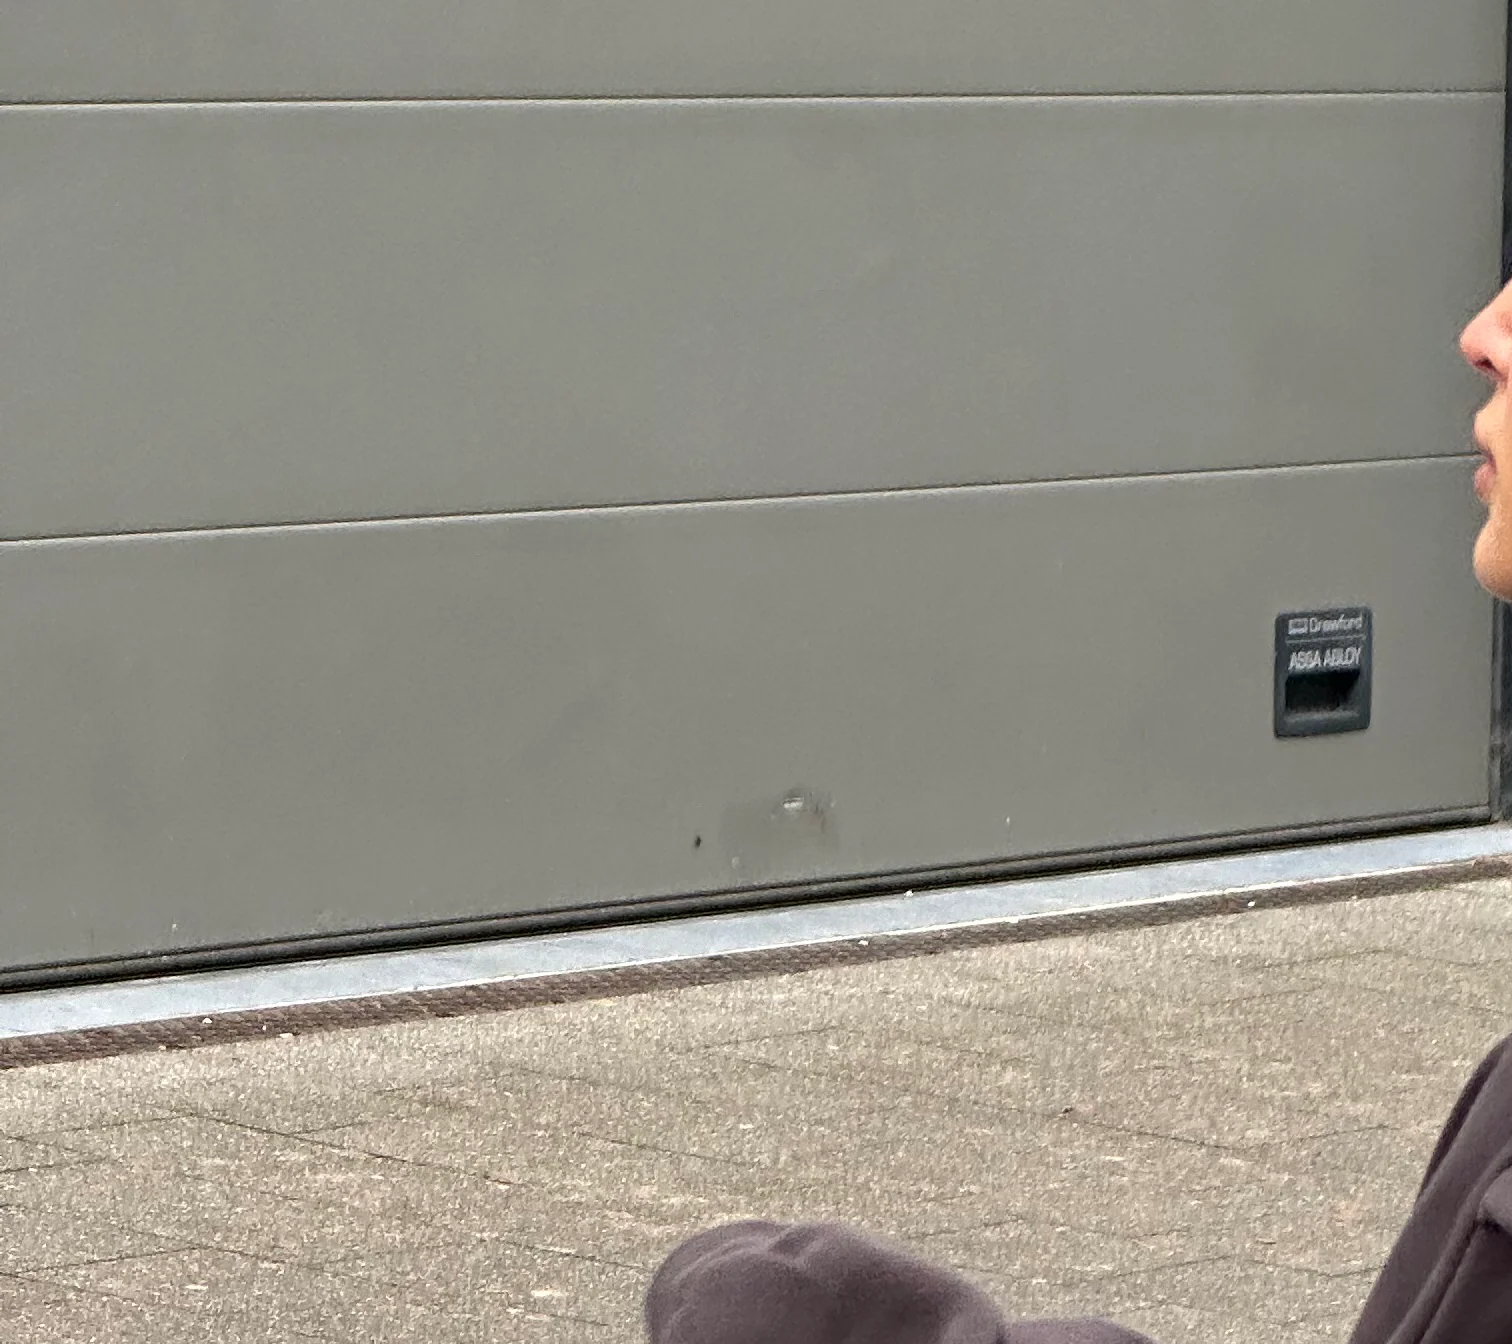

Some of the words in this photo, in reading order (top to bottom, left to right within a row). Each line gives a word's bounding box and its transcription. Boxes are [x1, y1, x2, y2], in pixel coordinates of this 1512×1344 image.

[1309, 613, 1363, 632] Crawford
[1288, 650, 1320, 670] ASSA
[1323, 647, 1361, 667] ABLOY
